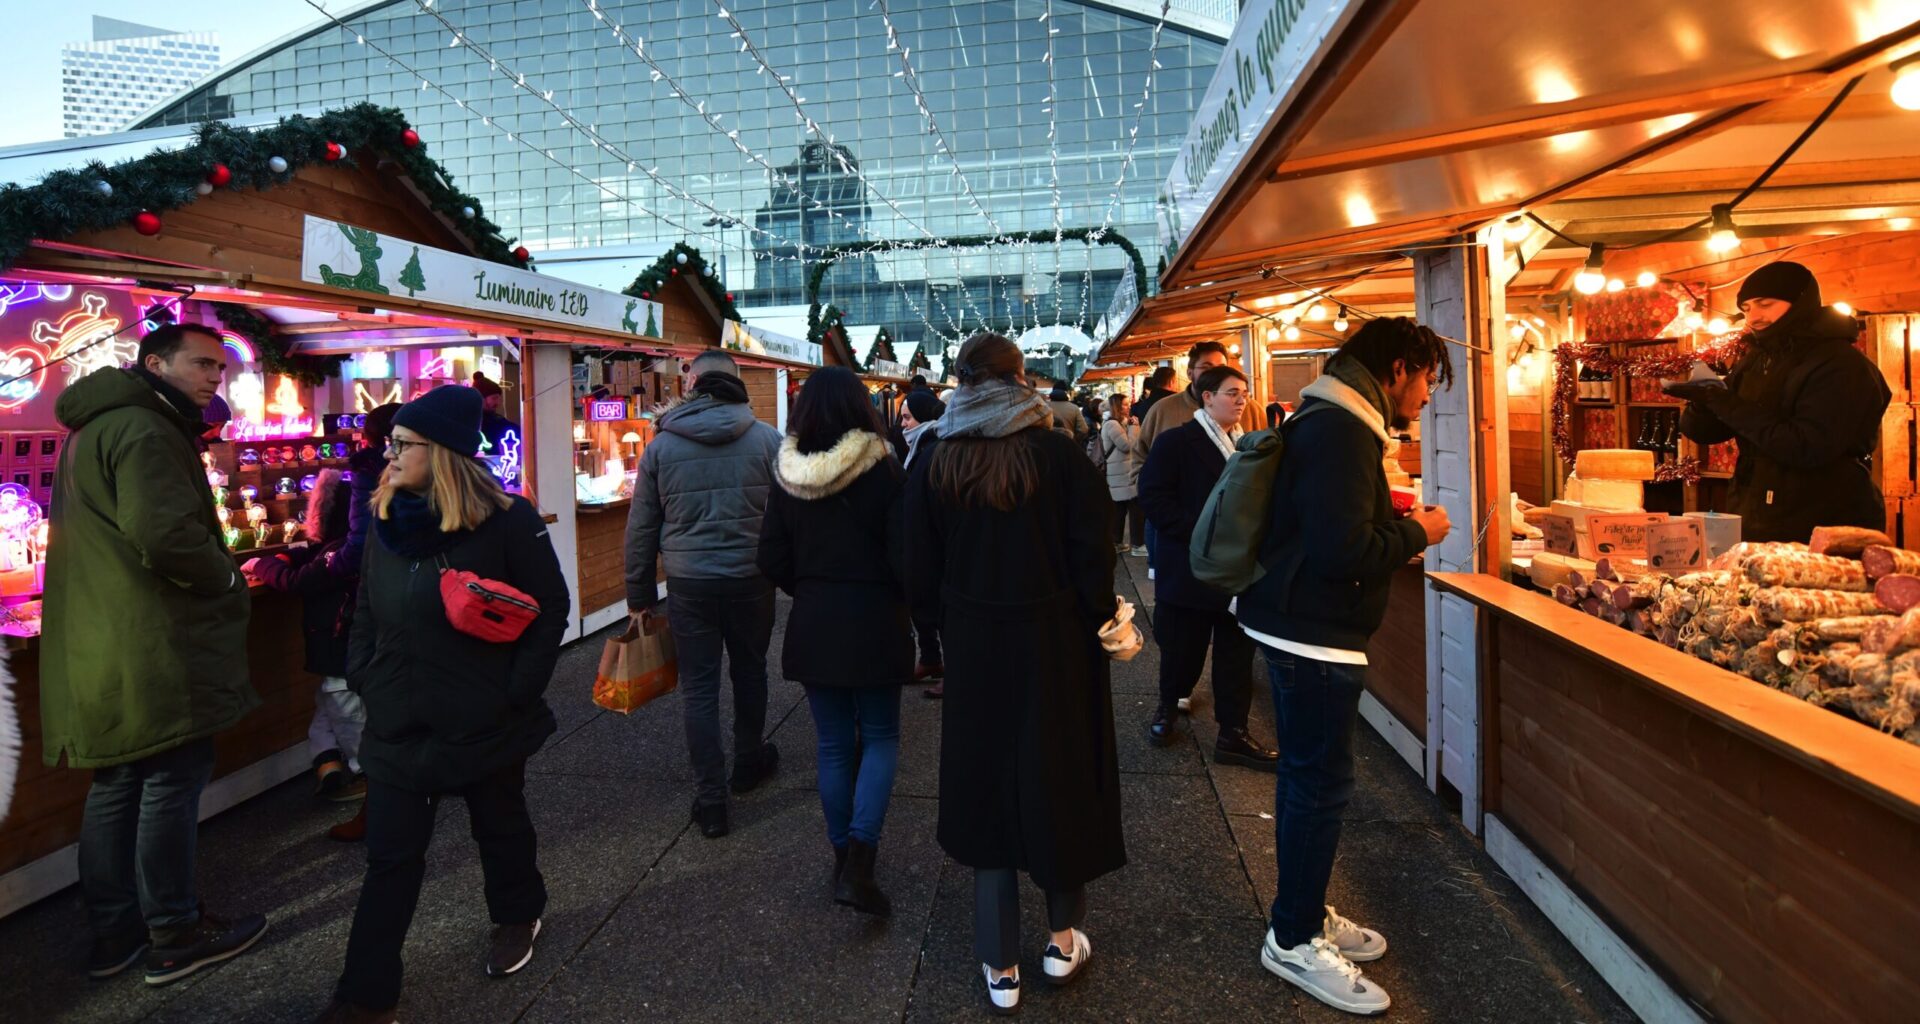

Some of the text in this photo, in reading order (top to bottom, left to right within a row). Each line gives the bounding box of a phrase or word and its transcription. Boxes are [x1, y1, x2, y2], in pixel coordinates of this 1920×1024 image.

[1236, 48, 1257, 110] la
[474, 271, 590, 317] Luminaire LED
[599, 404, 620, 417] BAR
